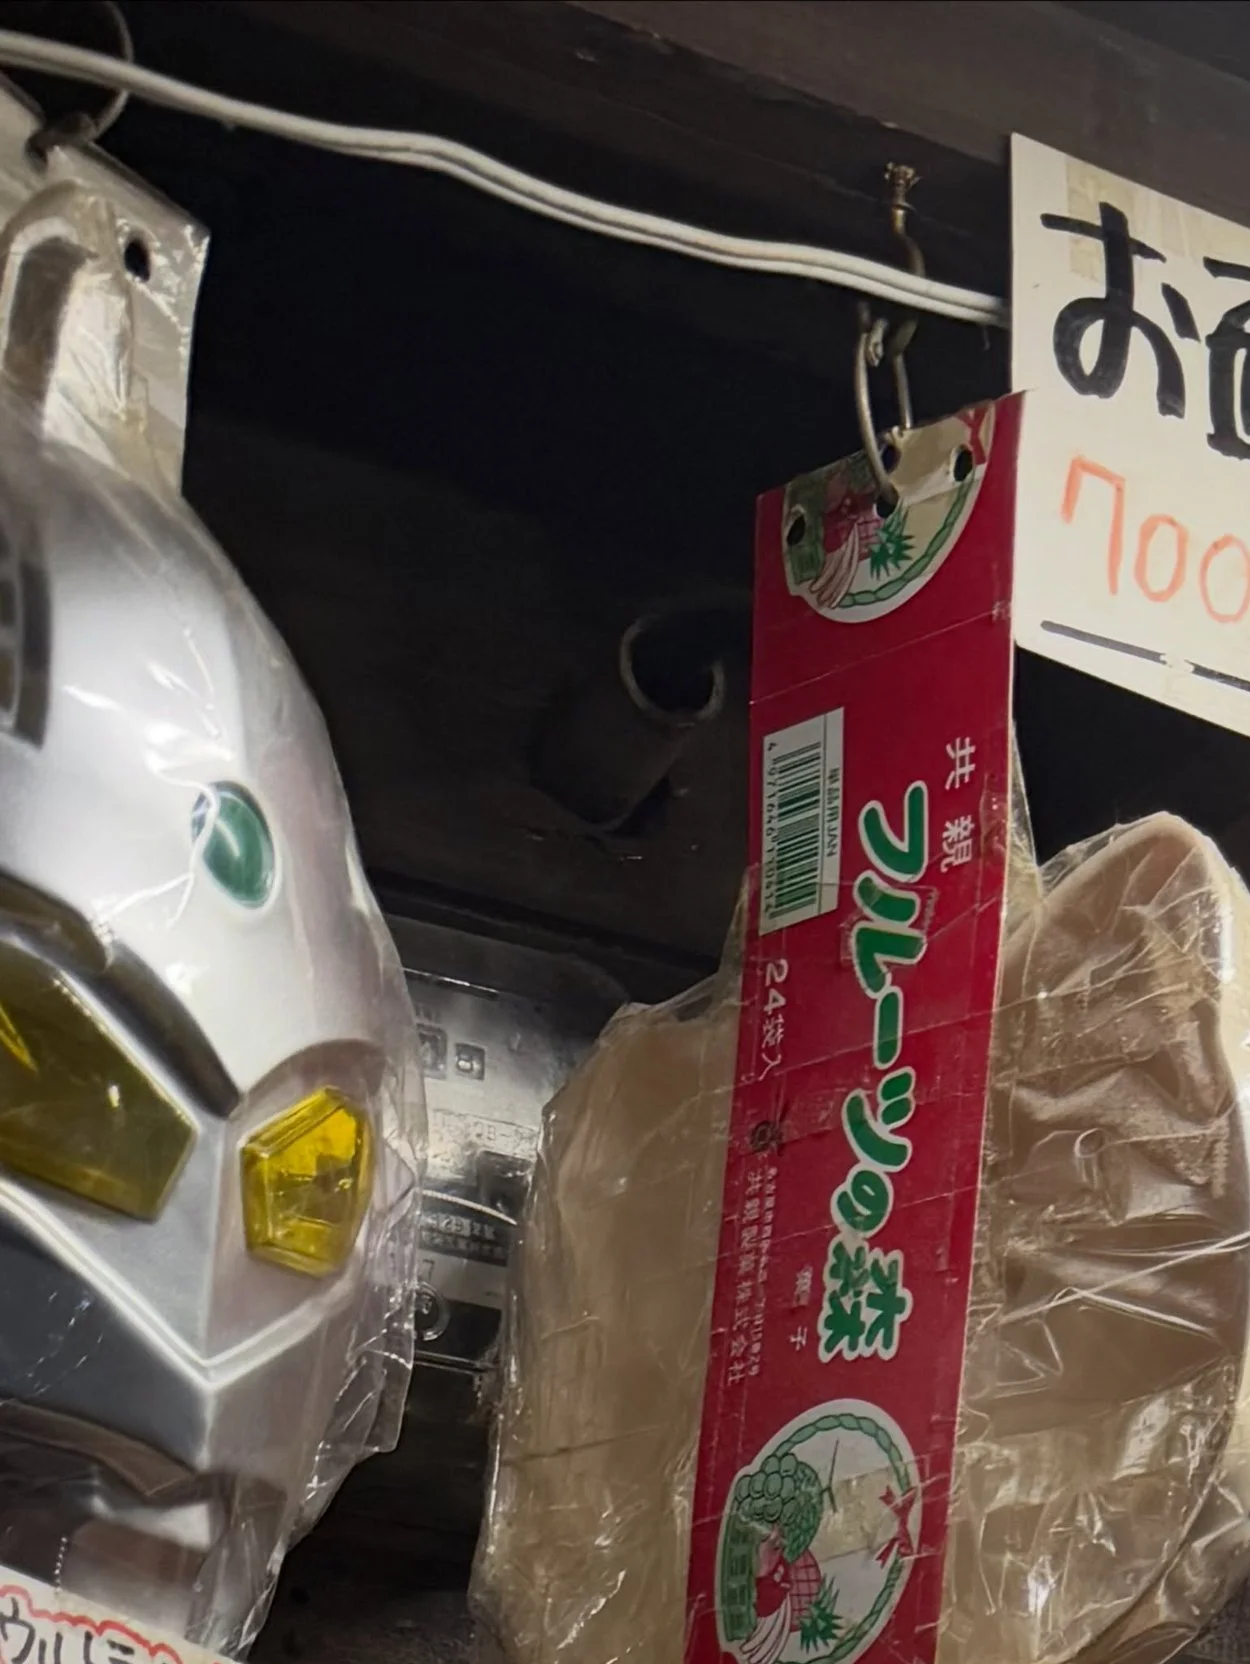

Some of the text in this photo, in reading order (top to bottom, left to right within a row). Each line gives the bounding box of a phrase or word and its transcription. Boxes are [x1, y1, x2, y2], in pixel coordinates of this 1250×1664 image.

[817, 780, 928, 1363] フルーツの森
